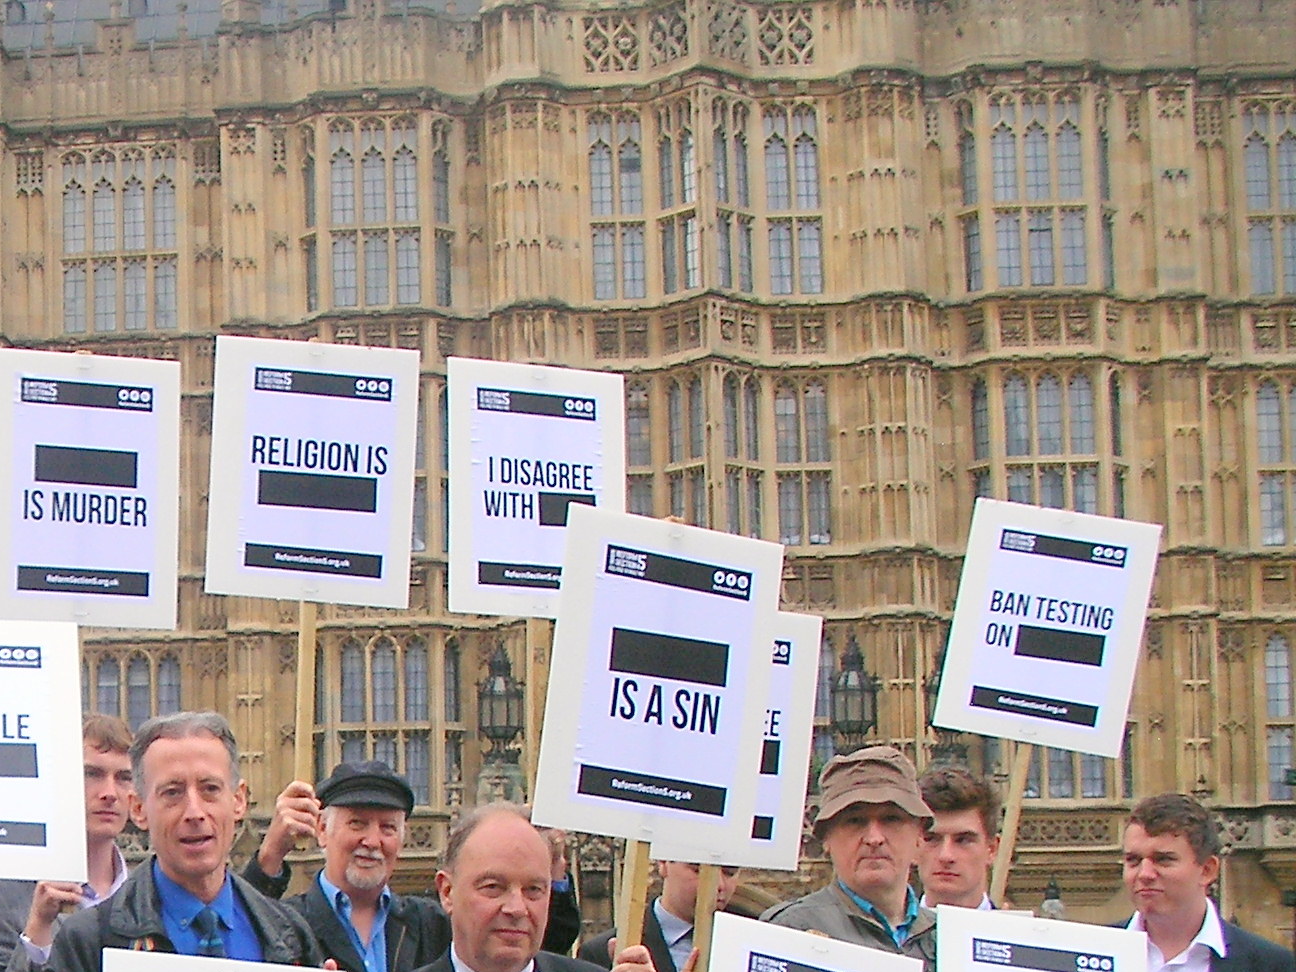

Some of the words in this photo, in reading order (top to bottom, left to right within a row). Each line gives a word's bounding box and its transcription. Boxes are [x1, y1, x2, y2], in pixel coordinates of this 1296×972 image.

[252, 436, 359, 472] RELIGION
[367, 446, 387, 475] IS
[490, 457, 493, 482] I
[501, 458, 593, 491] DISAGREE
[24, 490, 43, 520] IS
[52, 492, 146, 527] MURDER
[484, 490, 533, 519] WITH
[990, 590, 1030, 616] BAN
[1037, 597, 1113, 630] TESTING
[986, 623, 1012, 647] ON
[611, 678, 638, 719] IS
[644, 685, 662, 725] A
[672, 690, 720, 734] SIN
[764, 710, 781, 736] E
